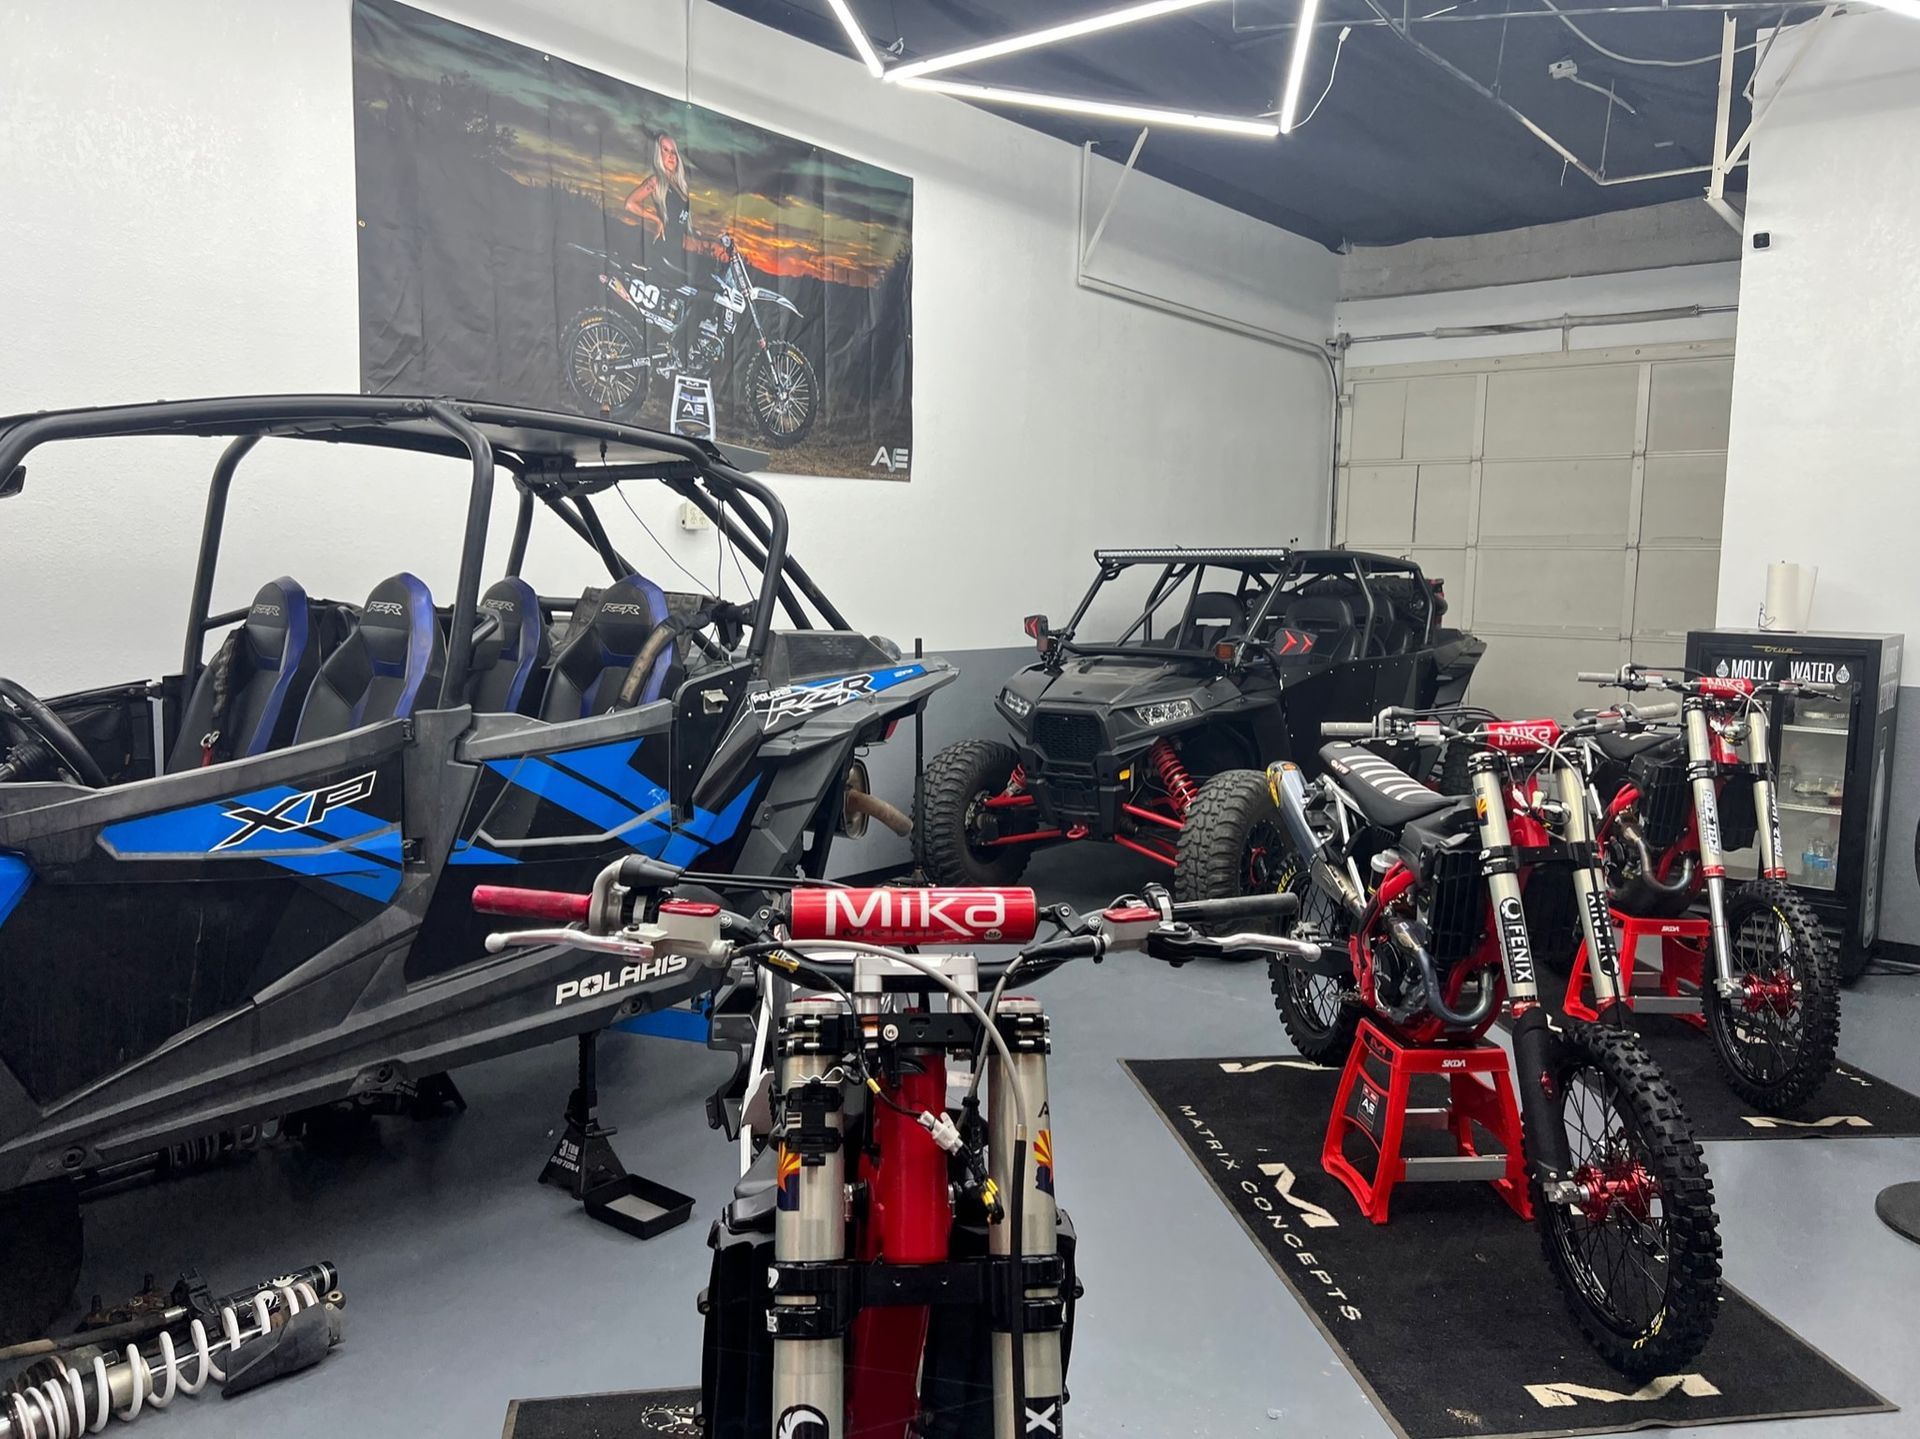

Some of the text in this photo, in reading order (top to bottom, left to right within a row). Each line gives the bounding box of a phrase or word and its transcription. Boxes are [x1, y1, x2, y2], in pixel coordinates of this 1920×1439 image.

[367, 601, 403, 616] RZR
[602, 603, 640, 615] RZR
[1731, 659, 1835, 683] MOLLY WATER
[752, 686, 792, 704] POLARIS
[208, 770, 377, 852] XP
[825, 889, 1006, 937] Mika
[1508, 924, 1533, 981] FENIX
[1178, 1104, 1364, 1321] MATRIX CONCEPTS
